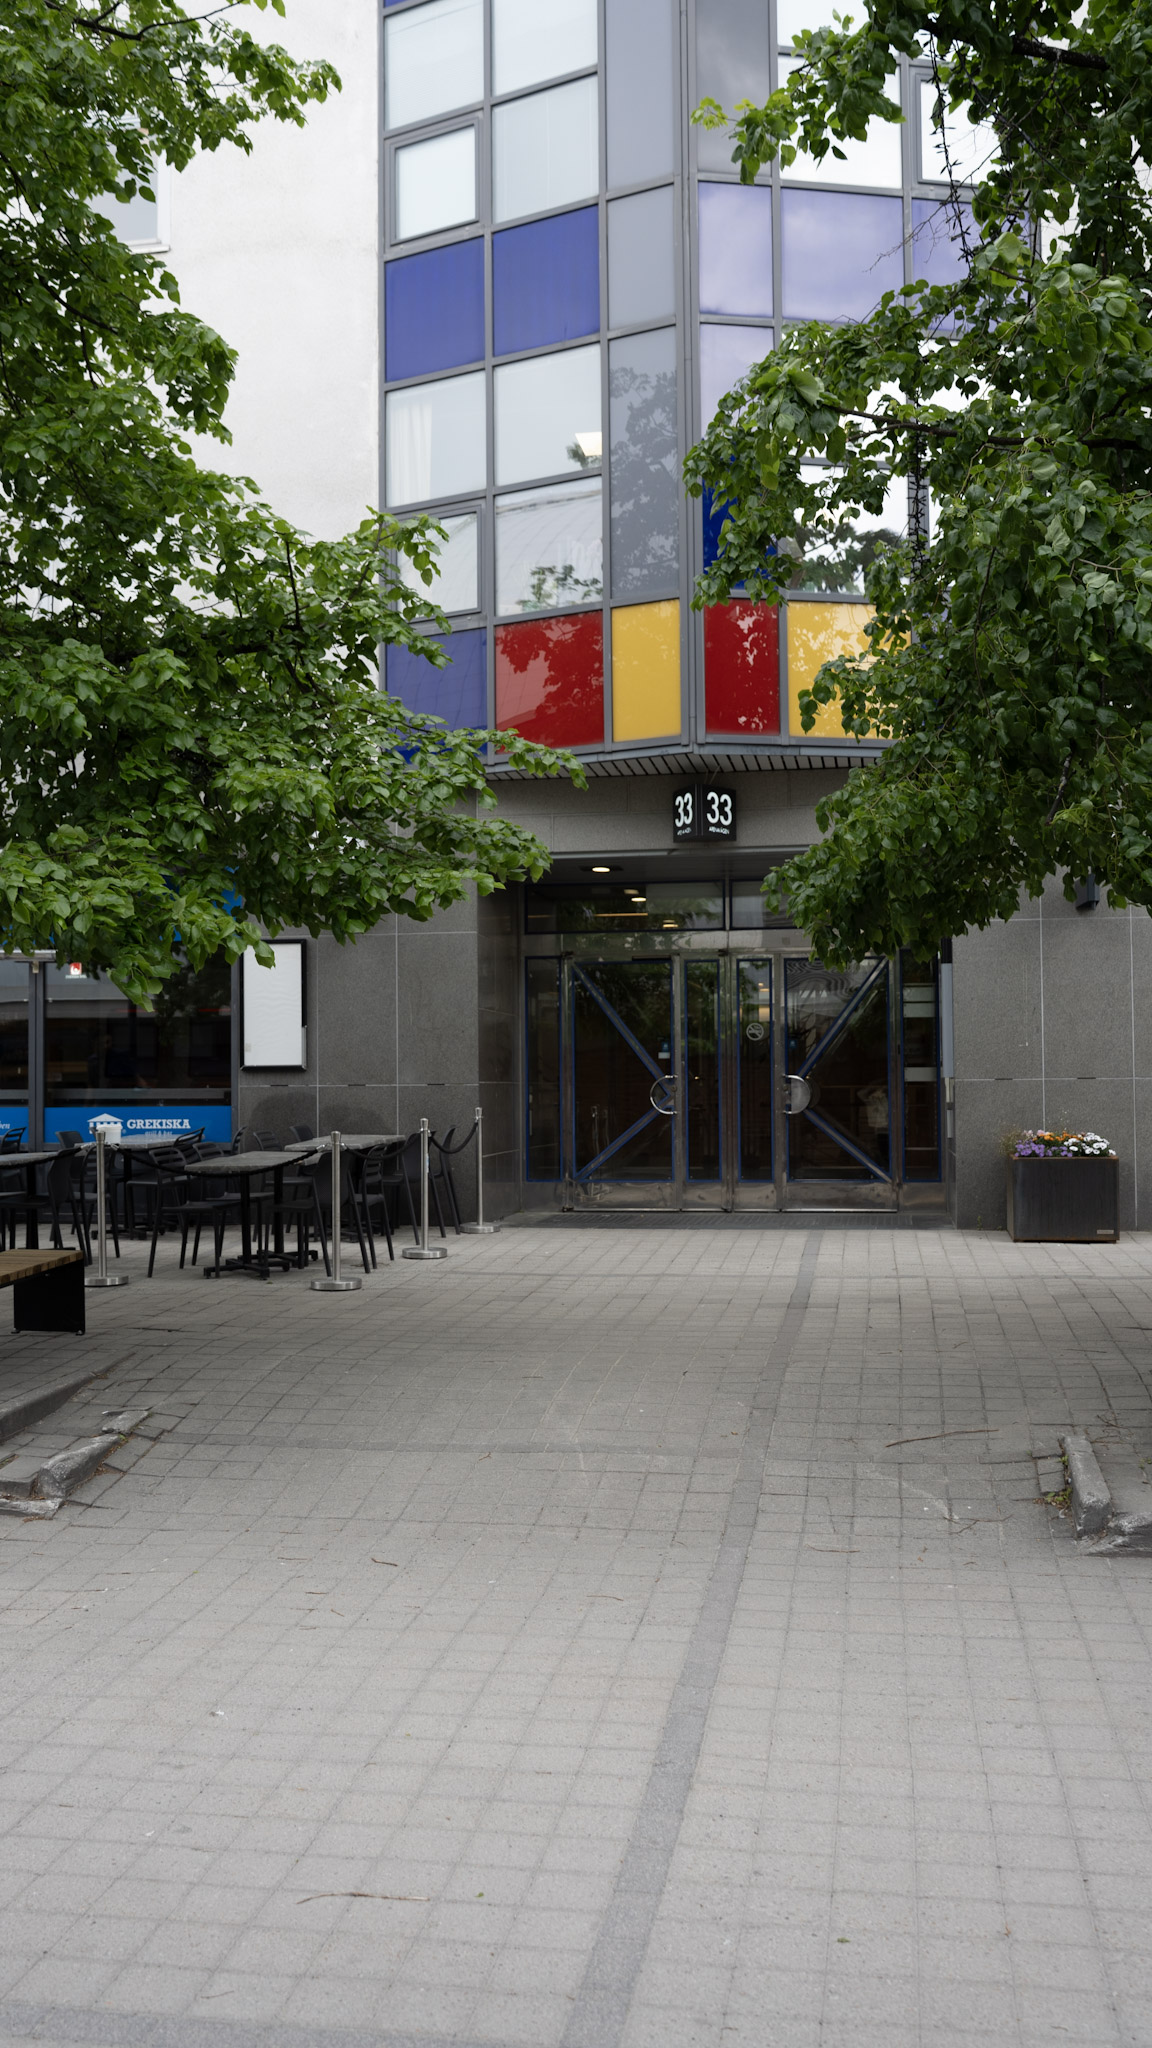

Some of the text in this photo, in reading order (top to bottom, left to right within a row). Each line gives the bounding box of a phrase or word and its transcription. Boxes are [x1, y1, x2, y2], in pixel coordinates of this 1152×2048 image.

[675, 792, 693, 827] 33
[707, 791, 732, 826] 33
[126, 1119, 191, 1129] GREKISKA
